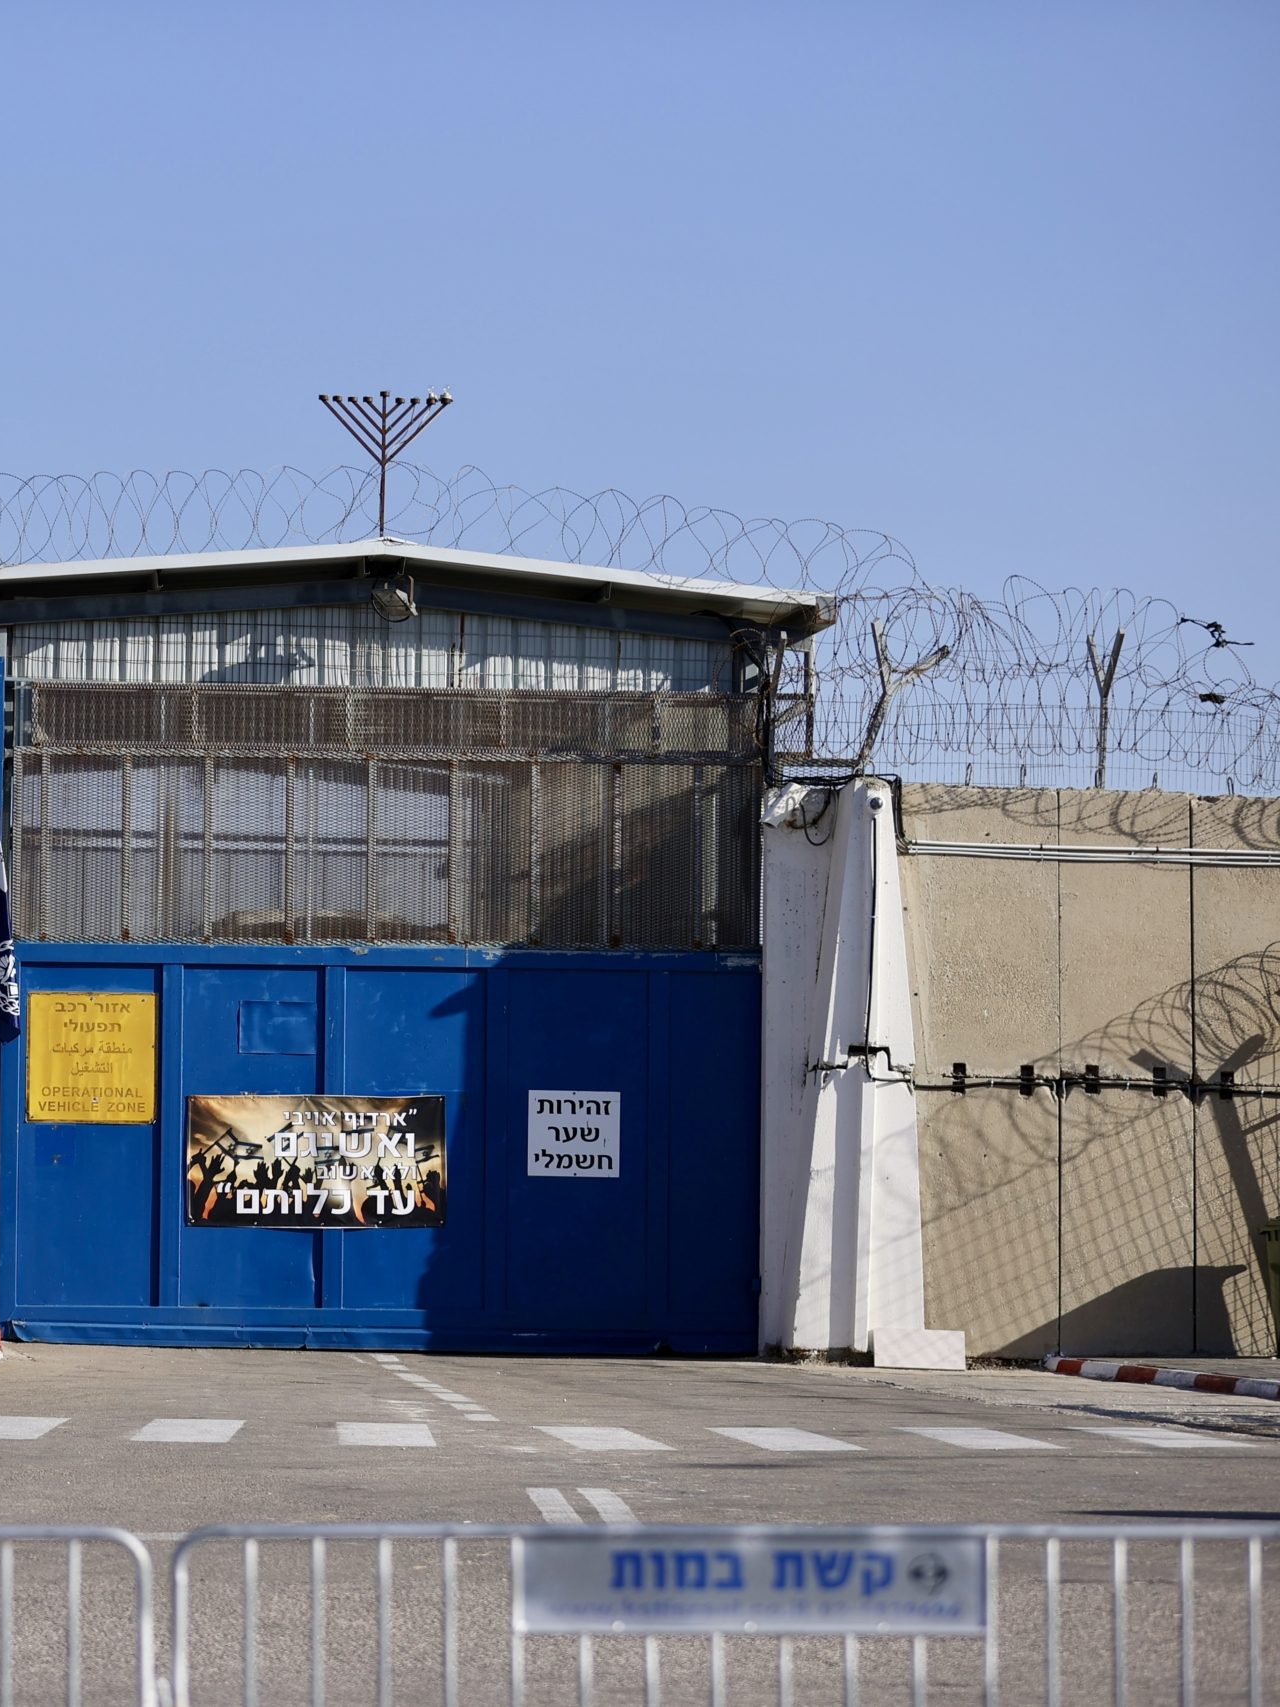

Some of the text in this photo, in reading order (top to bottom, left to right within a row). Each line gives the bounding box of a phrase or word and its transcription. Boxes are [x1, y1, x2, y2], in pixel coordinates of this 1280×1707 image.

[55, 1001, 131, 1013] אזור רכב
[63, 1018, 122, 1033] תפעולי
[52, 1041, 133, 1056] منطقة مركبات
[70, 1061, 113, 1076] التشغيل
[41, 1086, 143, 1098] OPERATIONAL
[38, 1101, 146, 1113] VEHICLE ZONE
[536, 1098, 612, 1116] זהירות
[283, 1110, 337, 1127] אויבי
[547, 1126, 600, 1143] שער
[274, 1131, 416, 1159] ואשיגם
[534, 1148, 613, 1170] חשמלי
[316, 1162, 418, 1181] ולא אשוב
[370, 1188, 416, 1216] עד
[609, 1549, 897, 1598] קשת במות
